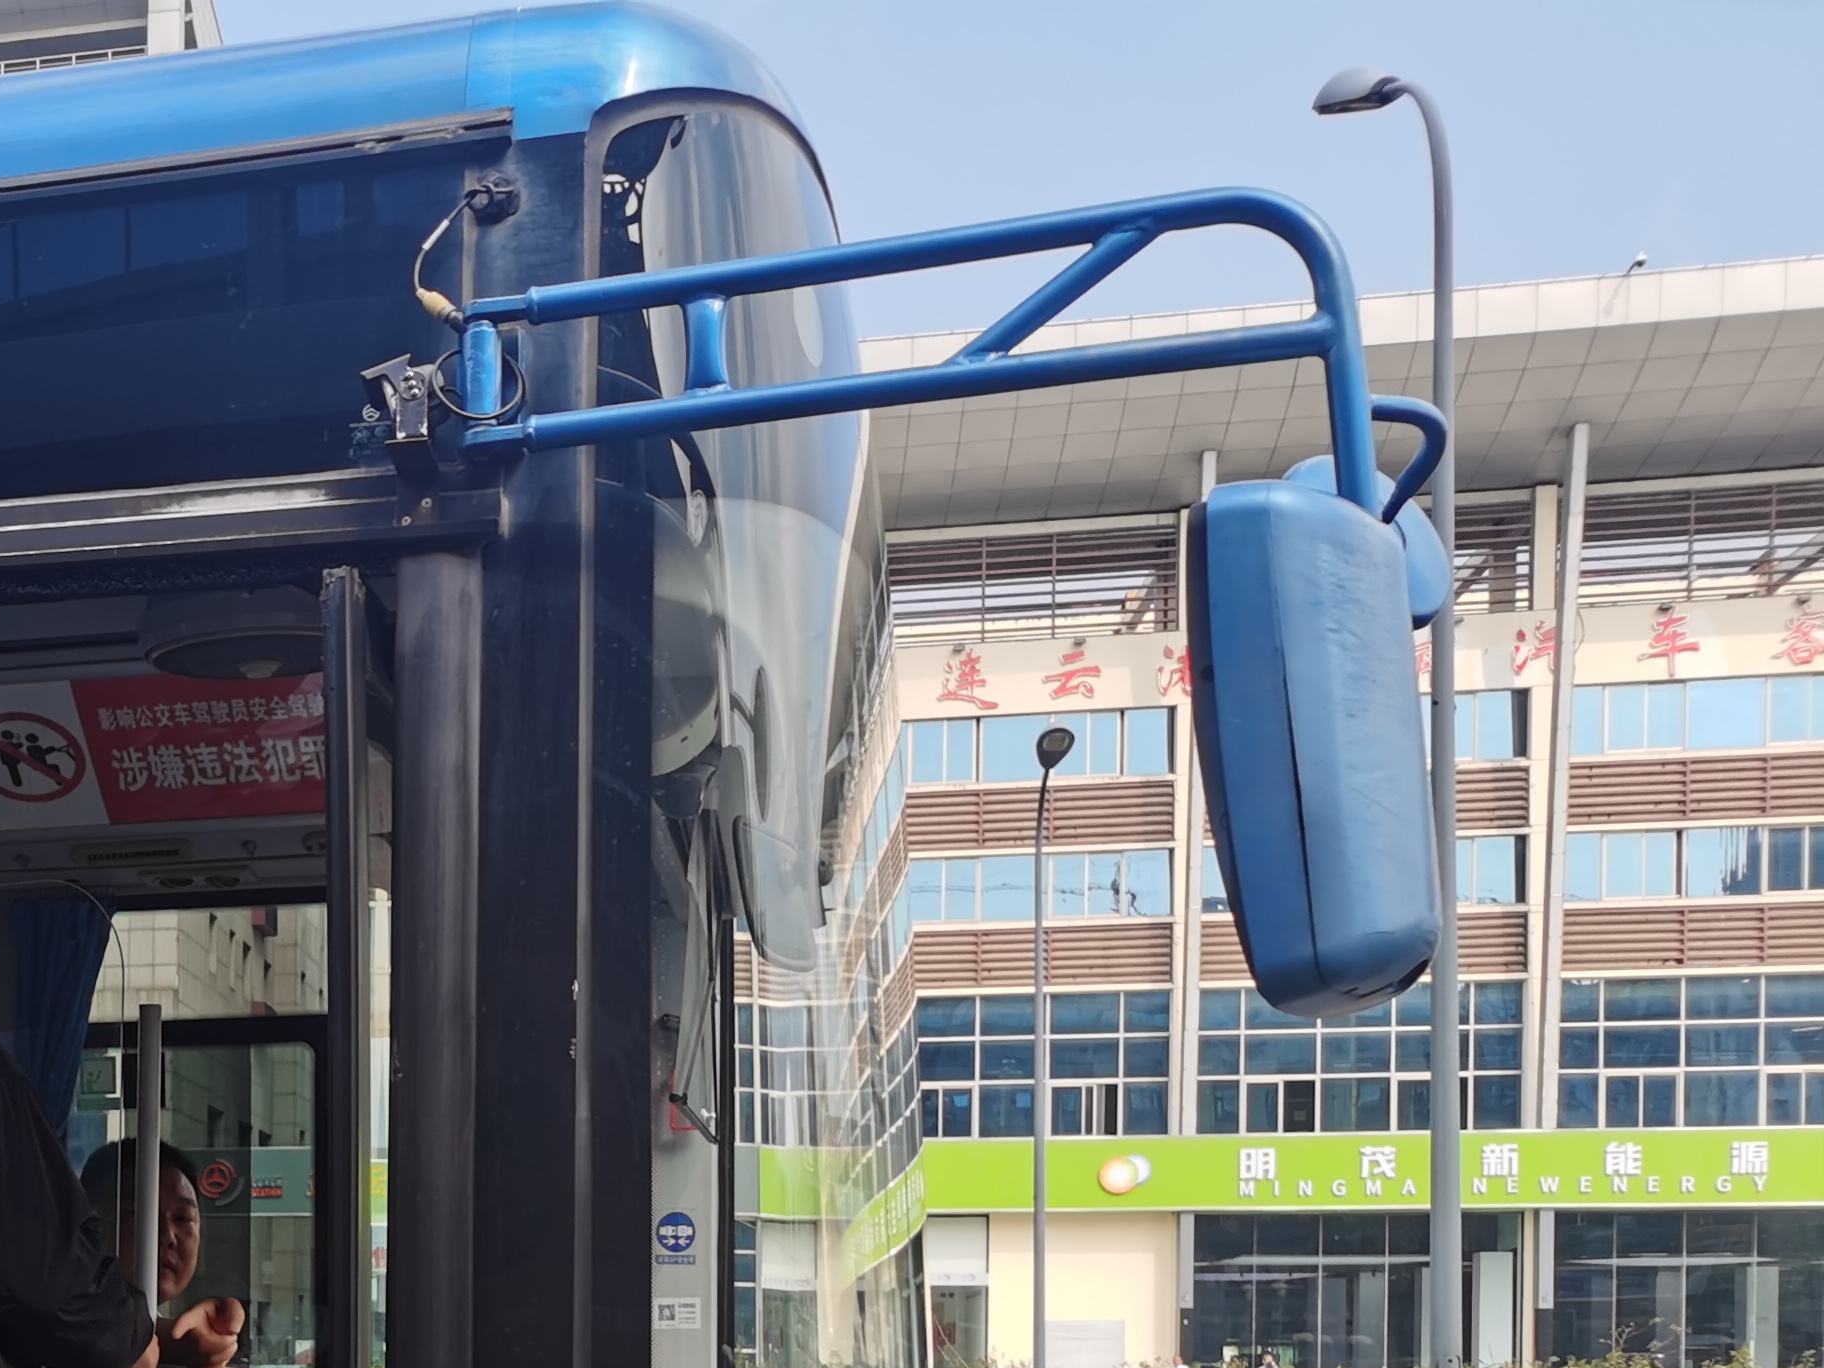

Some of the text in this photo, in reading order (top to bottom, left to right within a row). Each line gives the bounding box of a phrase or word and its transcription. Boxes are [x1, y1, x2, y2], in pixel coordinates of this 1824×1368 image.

[111, 735, 325, 792] 涉嫌违法犯罪
[1239, 1141, 1769, 1181] 明茂新能源
